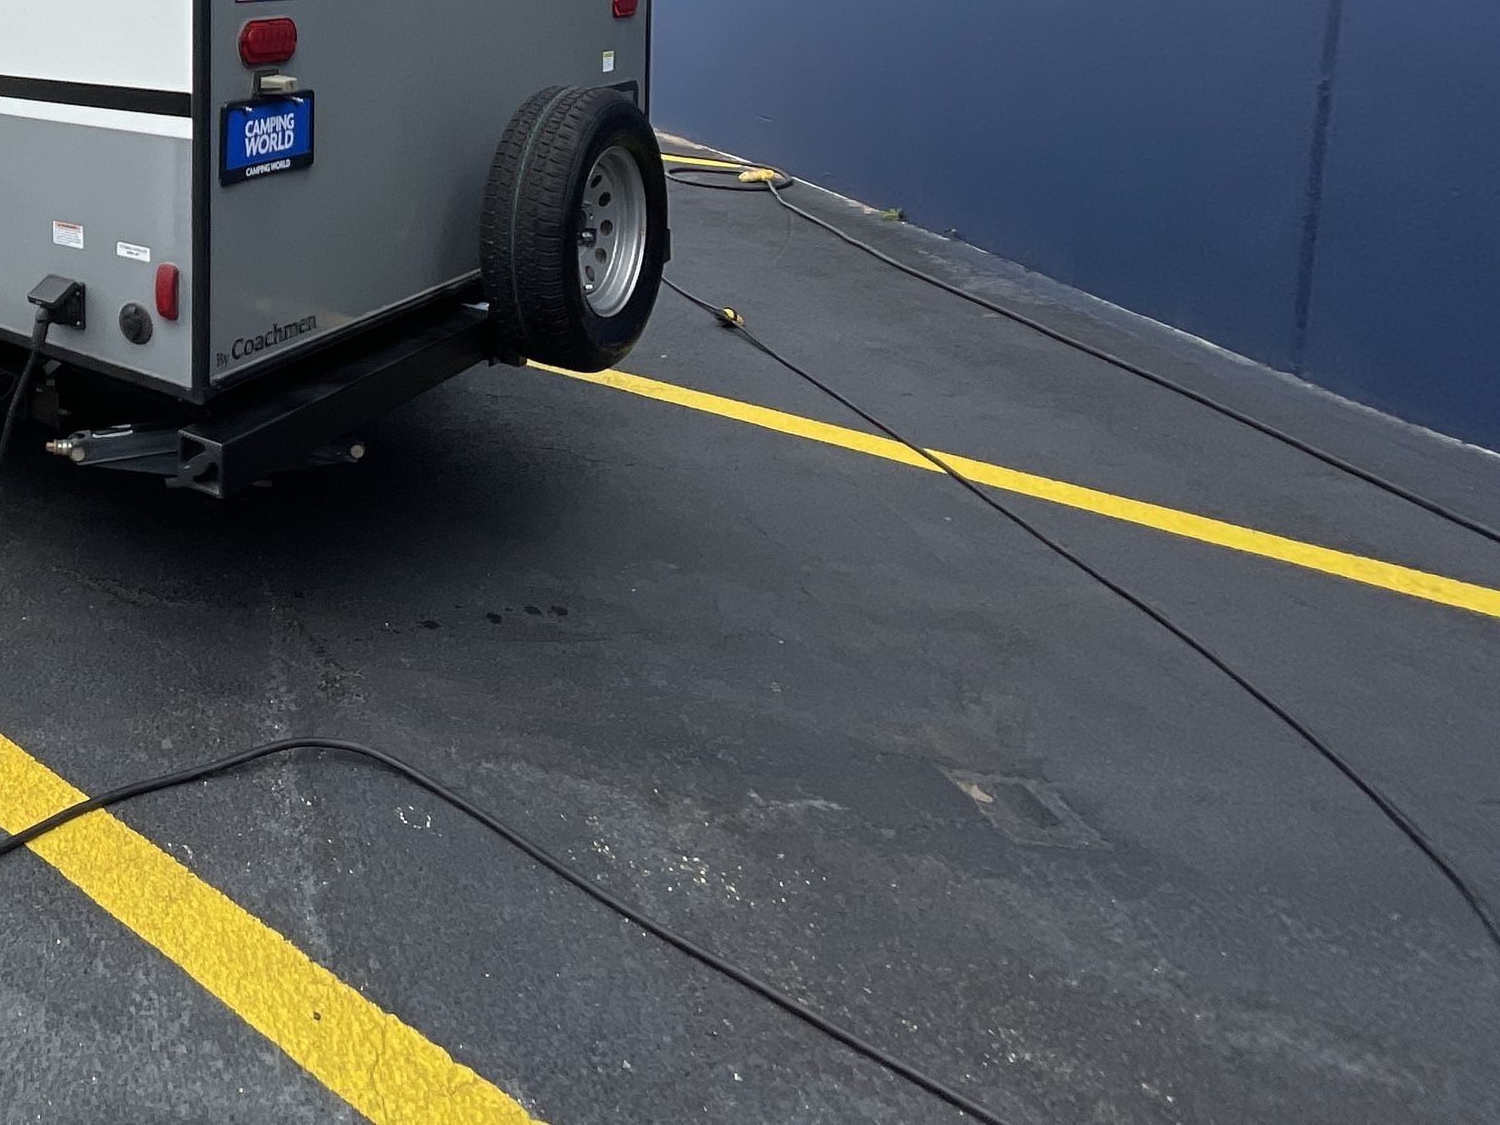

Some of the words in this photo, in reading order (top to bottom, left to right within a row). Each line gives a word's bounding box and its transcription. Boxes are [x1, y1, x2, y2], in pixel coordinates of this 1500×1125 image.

[245, 113, 295, 138] CAMPING
[245, 130, 295, 158] WORLD
[231, 314, 317, 360] Coachmen
